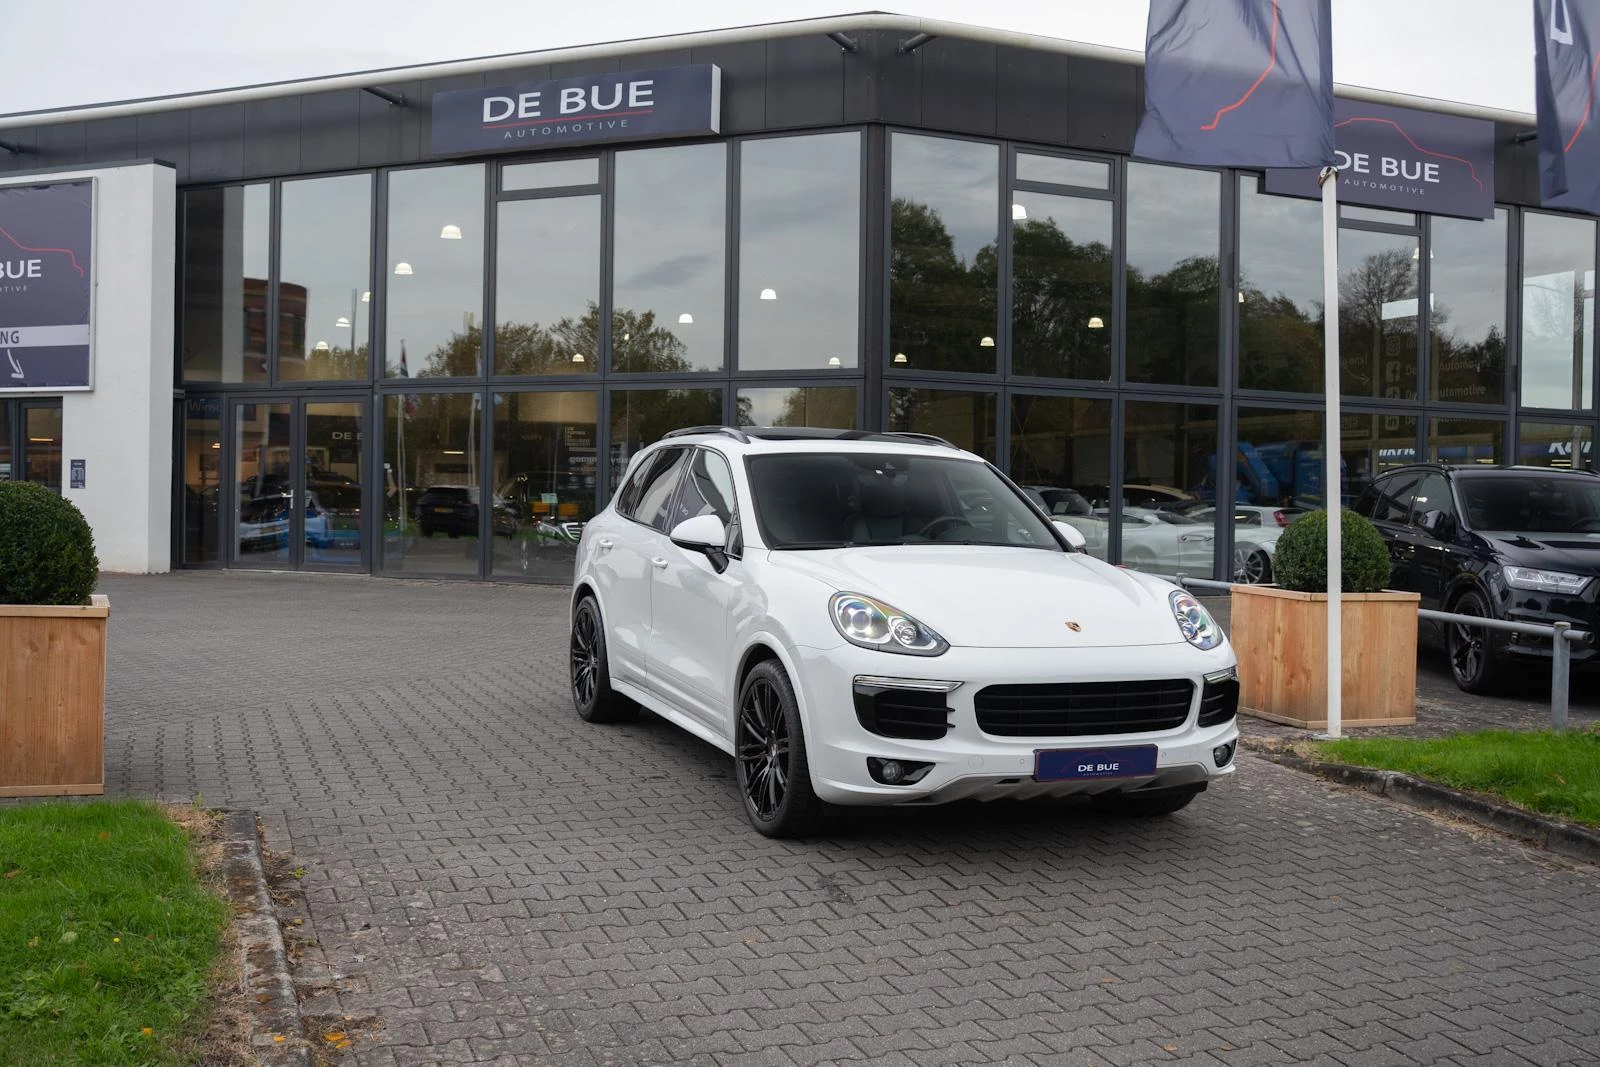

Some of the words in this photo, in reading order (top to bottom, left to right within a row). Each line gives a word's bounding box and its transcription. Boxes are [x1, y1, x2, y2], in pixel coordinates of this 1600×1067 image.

[482, 91, 542, 123] DE
[559, 80, 654, 115] BUE
[503, 119, 629, 139] AUTOMOTIVE
[1382, 156, 1440, 183] BUE
[1344, 178, 1425, 196] AUTOMOTIVE
[1097, 763, 1119, 771] BUE
